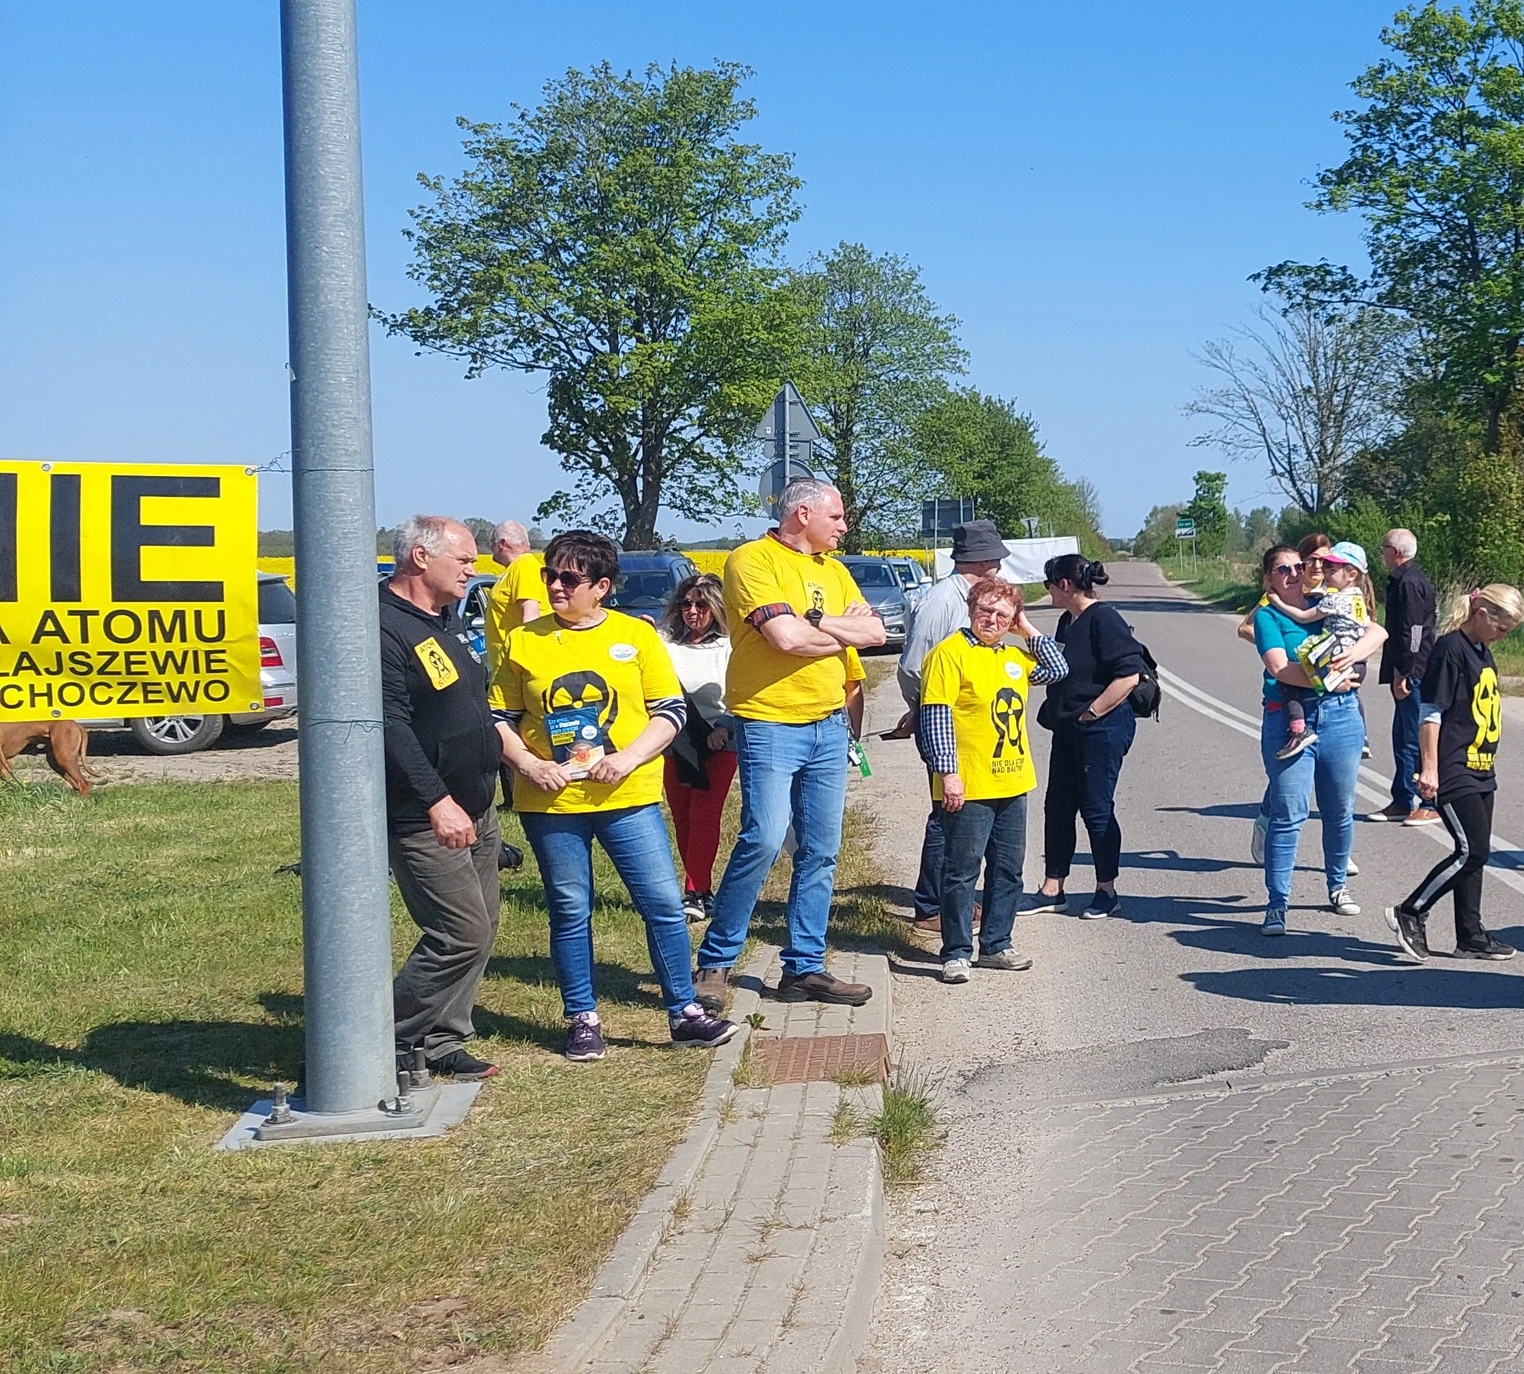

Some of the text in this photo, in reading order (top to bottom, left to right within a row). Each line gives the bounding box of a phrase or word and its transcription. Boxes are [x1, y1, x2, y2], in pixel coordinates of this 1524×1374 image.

[0, 473, 224, 602] IE
[31, 609, 226, 644] ATOMU
[0, 649, 229, 677] AJSZEWIE
[0, 680, 230, 709] CHOCZEWO
